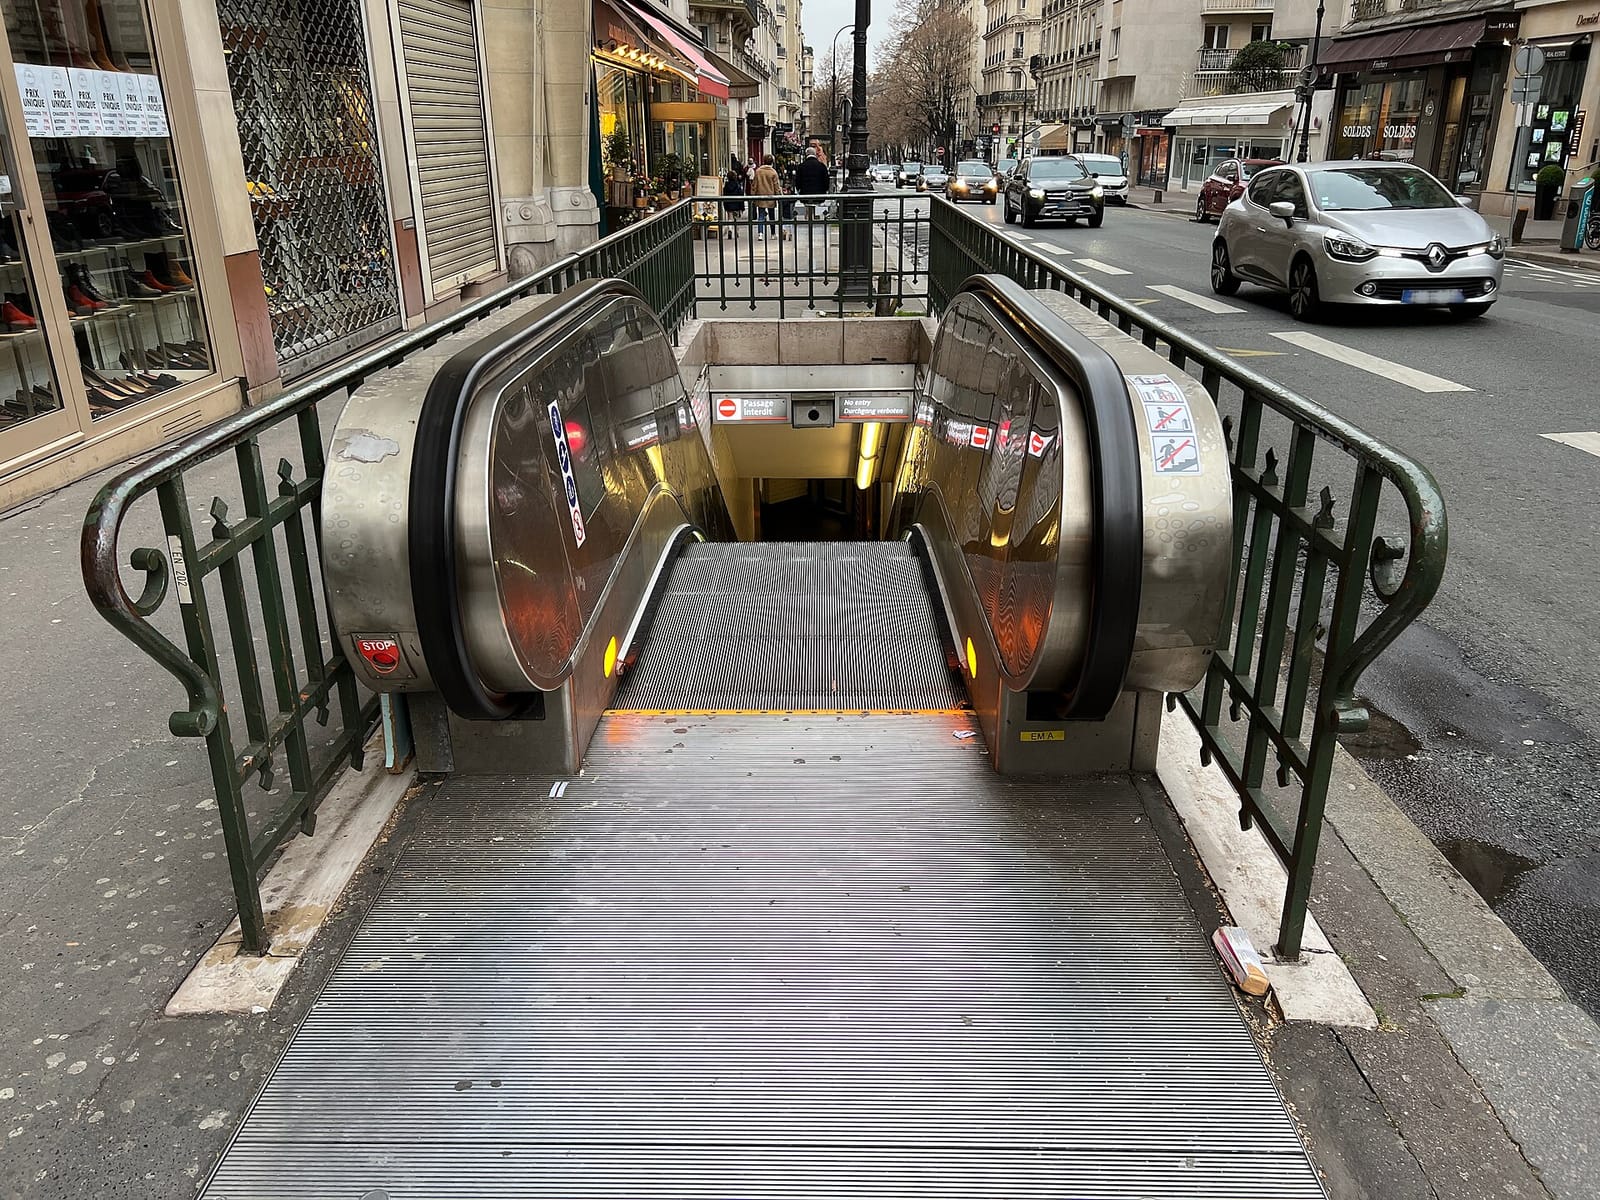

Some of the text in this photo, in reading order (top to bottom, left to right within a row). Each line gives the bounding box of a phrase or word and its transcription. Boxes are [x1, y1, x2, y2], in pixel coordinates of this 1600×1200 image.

[25, 88, 40, 98] PRIX
[53, 90, 67, 99] PRIX
[78, 91, 91, 101] PRIX
[23, 98, 45, 108] UNIQUE
[51, 100, 72, 109] UNIQUE
[1342, 125, 1372, 138] SOLDES
[1383, 125, 1417, 138] SOLDES
[743, 400, 774, 408] Passage
[843, 408, 876, 416] Durchgang
[172, 551, 187, 587] EN 202
[362, 641, 391, 651] STOP
[1048, 731, 1054, 739] A
